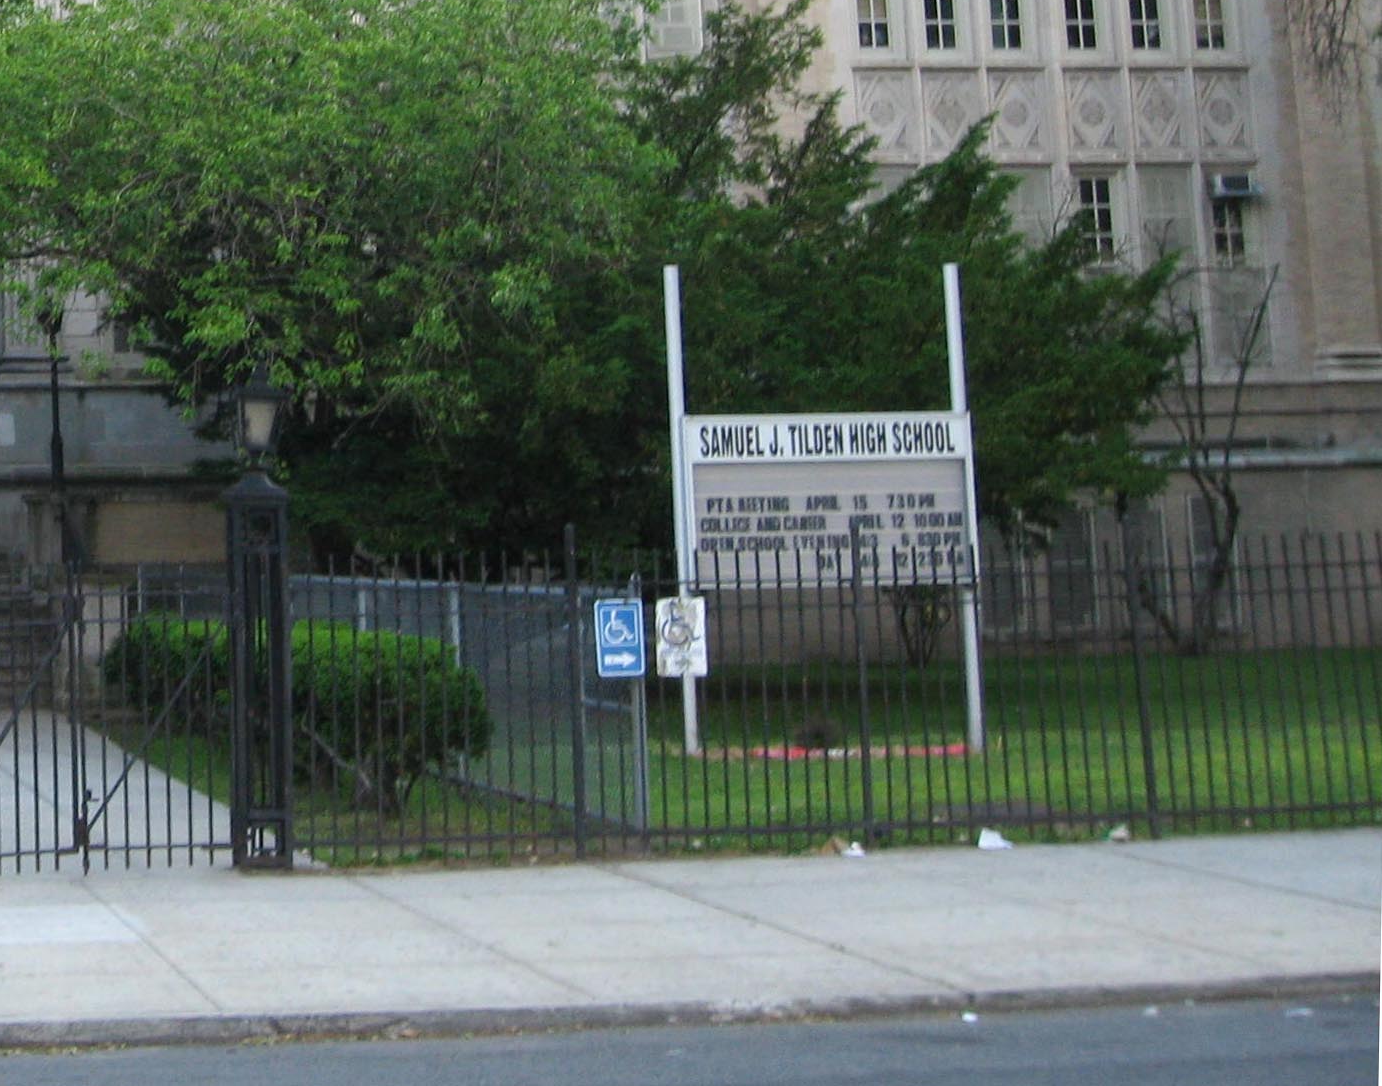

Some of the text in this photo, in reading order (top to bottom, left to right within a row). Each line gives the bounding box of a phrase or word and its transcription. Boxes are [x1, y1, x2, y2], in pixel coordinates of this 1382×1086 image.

[700, 421, 955, 457] SAMUEL J. TILDEN HIGH SCHOOL
[707, 498, 733, 513] PTA
[738, 497, 789, 512] MEETING
[806, 496, 841, 511] APRIL
[757, 516, 781, 531] AND
[783, 515, 826, 530] CAREER
[701, 537, 734, 552] OPEN
[738, 536, 788, 551] SCHOOL
[793, 534, 849, 550] EVENING
